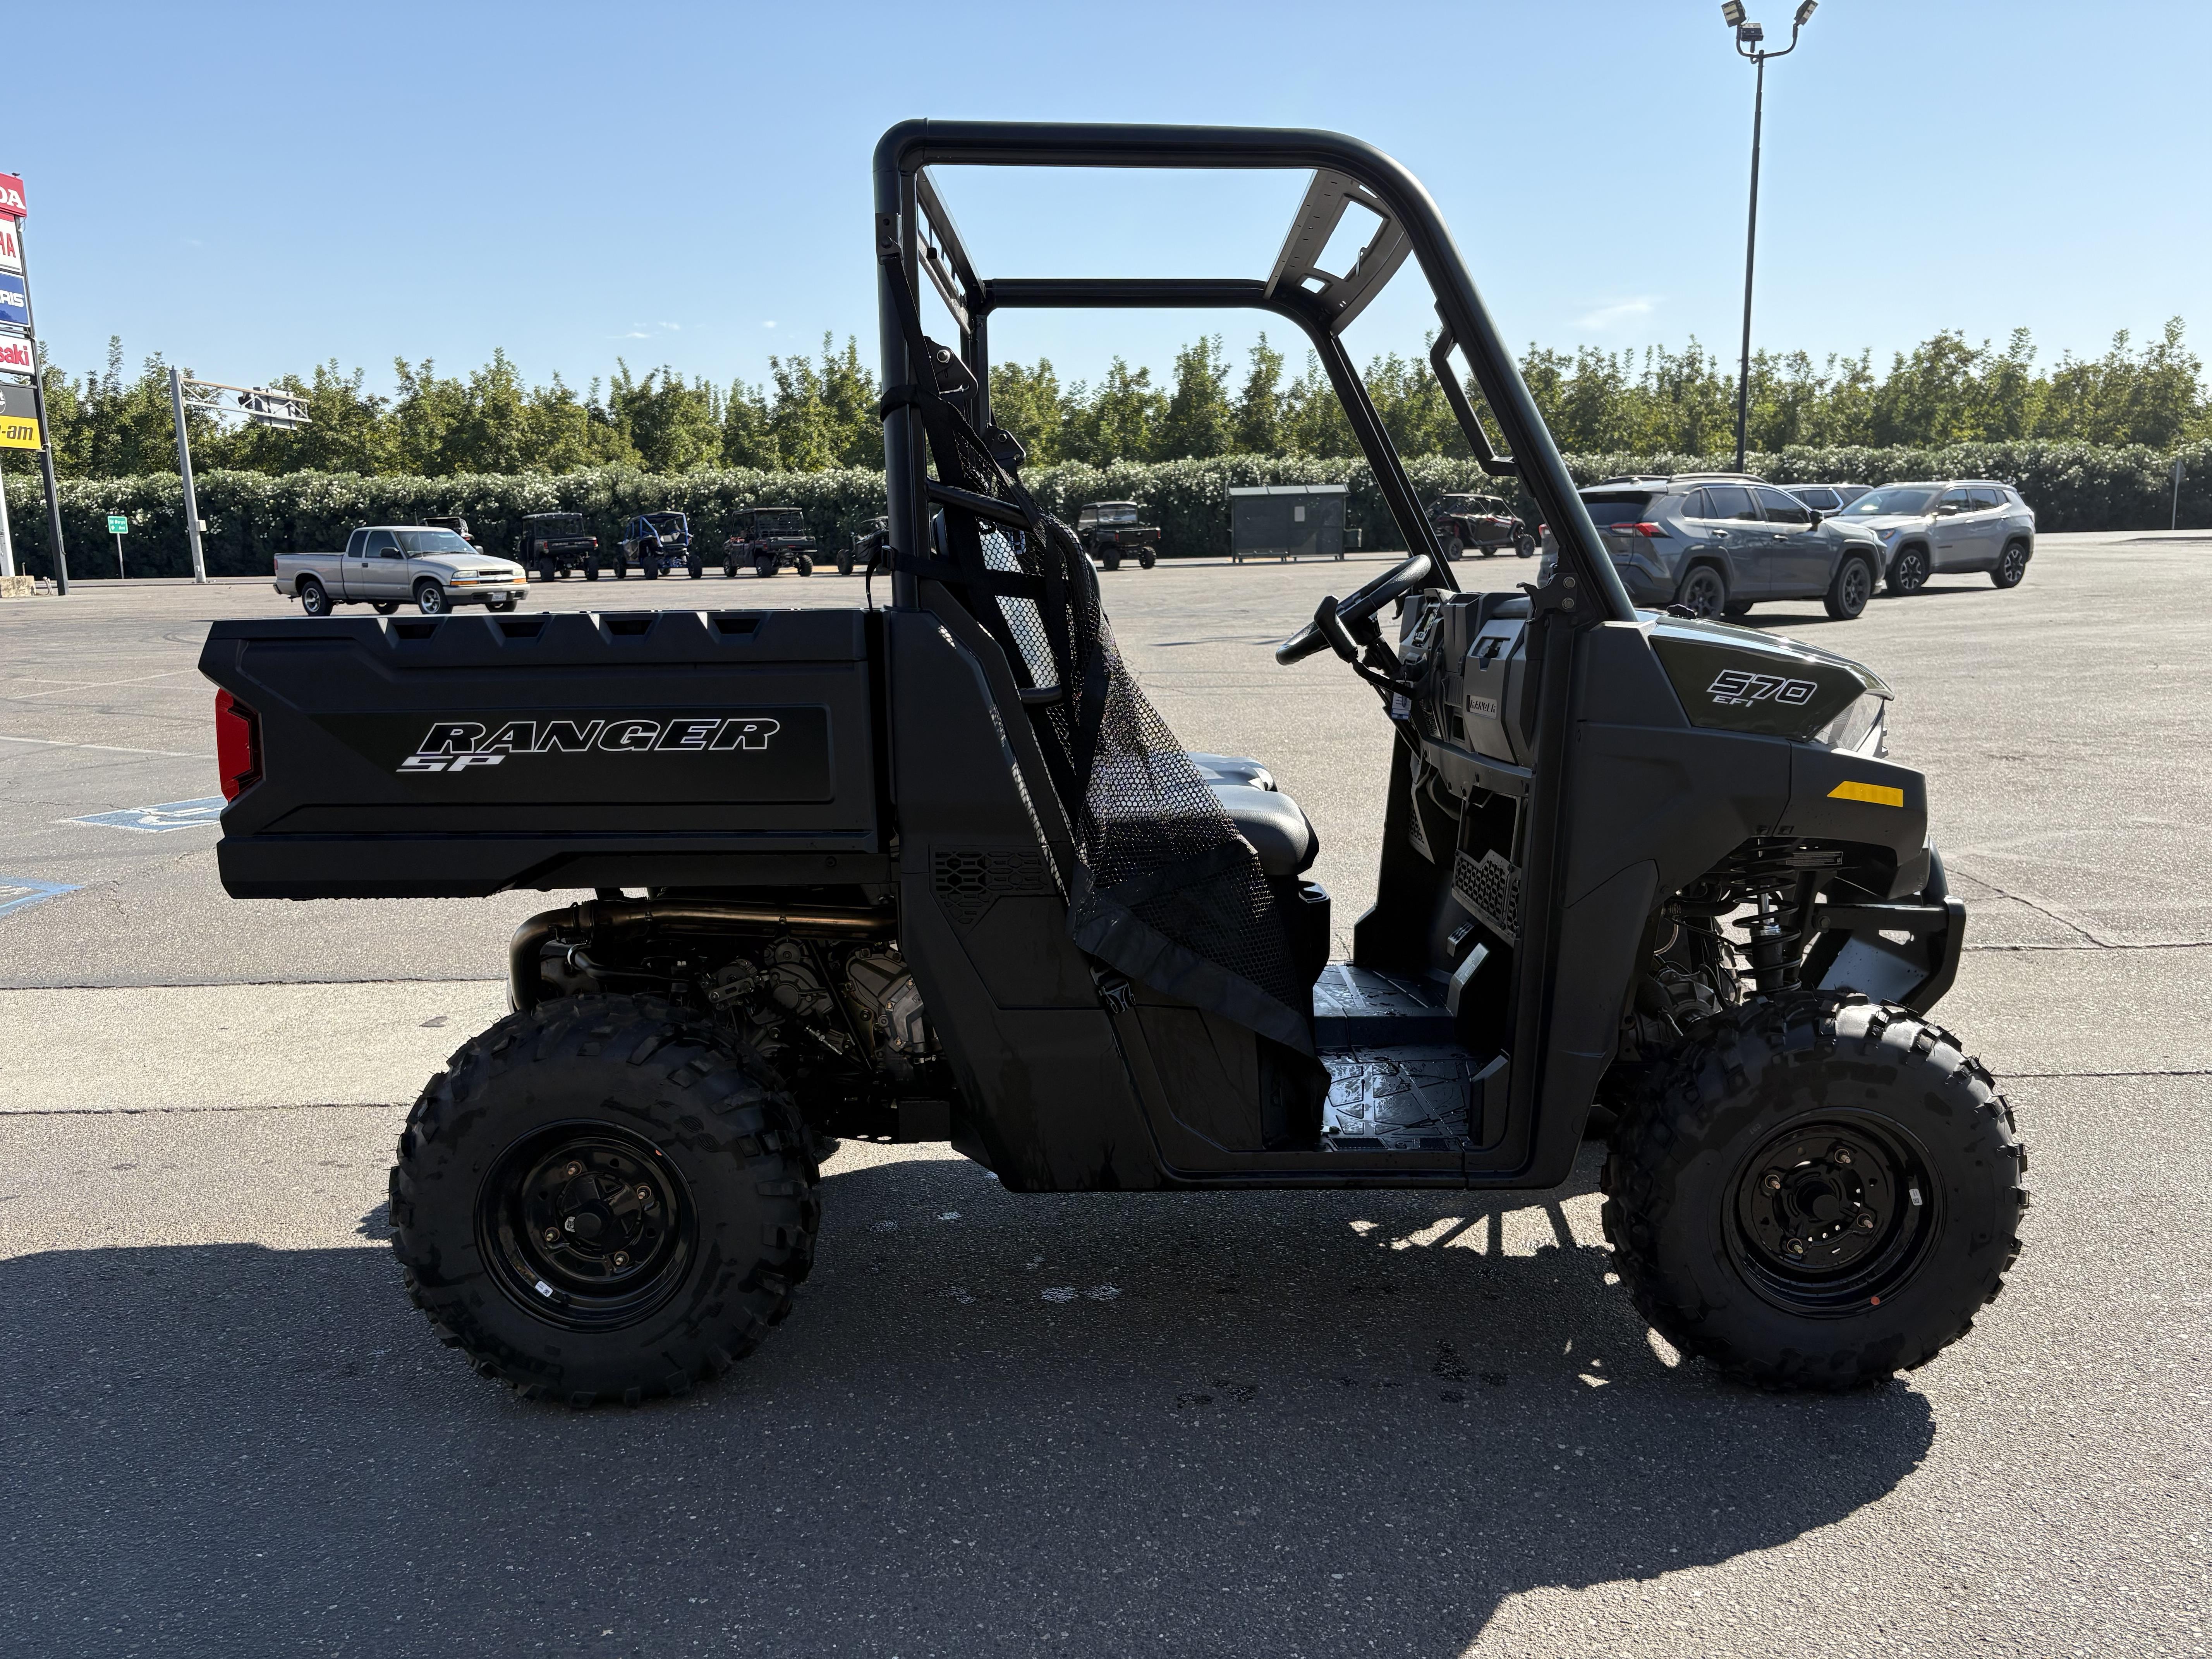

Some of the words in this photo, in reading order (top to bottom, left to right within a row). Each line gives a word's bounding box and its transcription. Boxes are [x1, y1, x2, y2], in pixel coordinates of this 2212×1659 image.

[0, 290, 24, 307] RIS
[1706, 669, 1817, 705] 570
[1712, 695, 1753, 707] EFI
[416, 718, 780, 754] RANGER
[395, 755, 506, 772] SP
